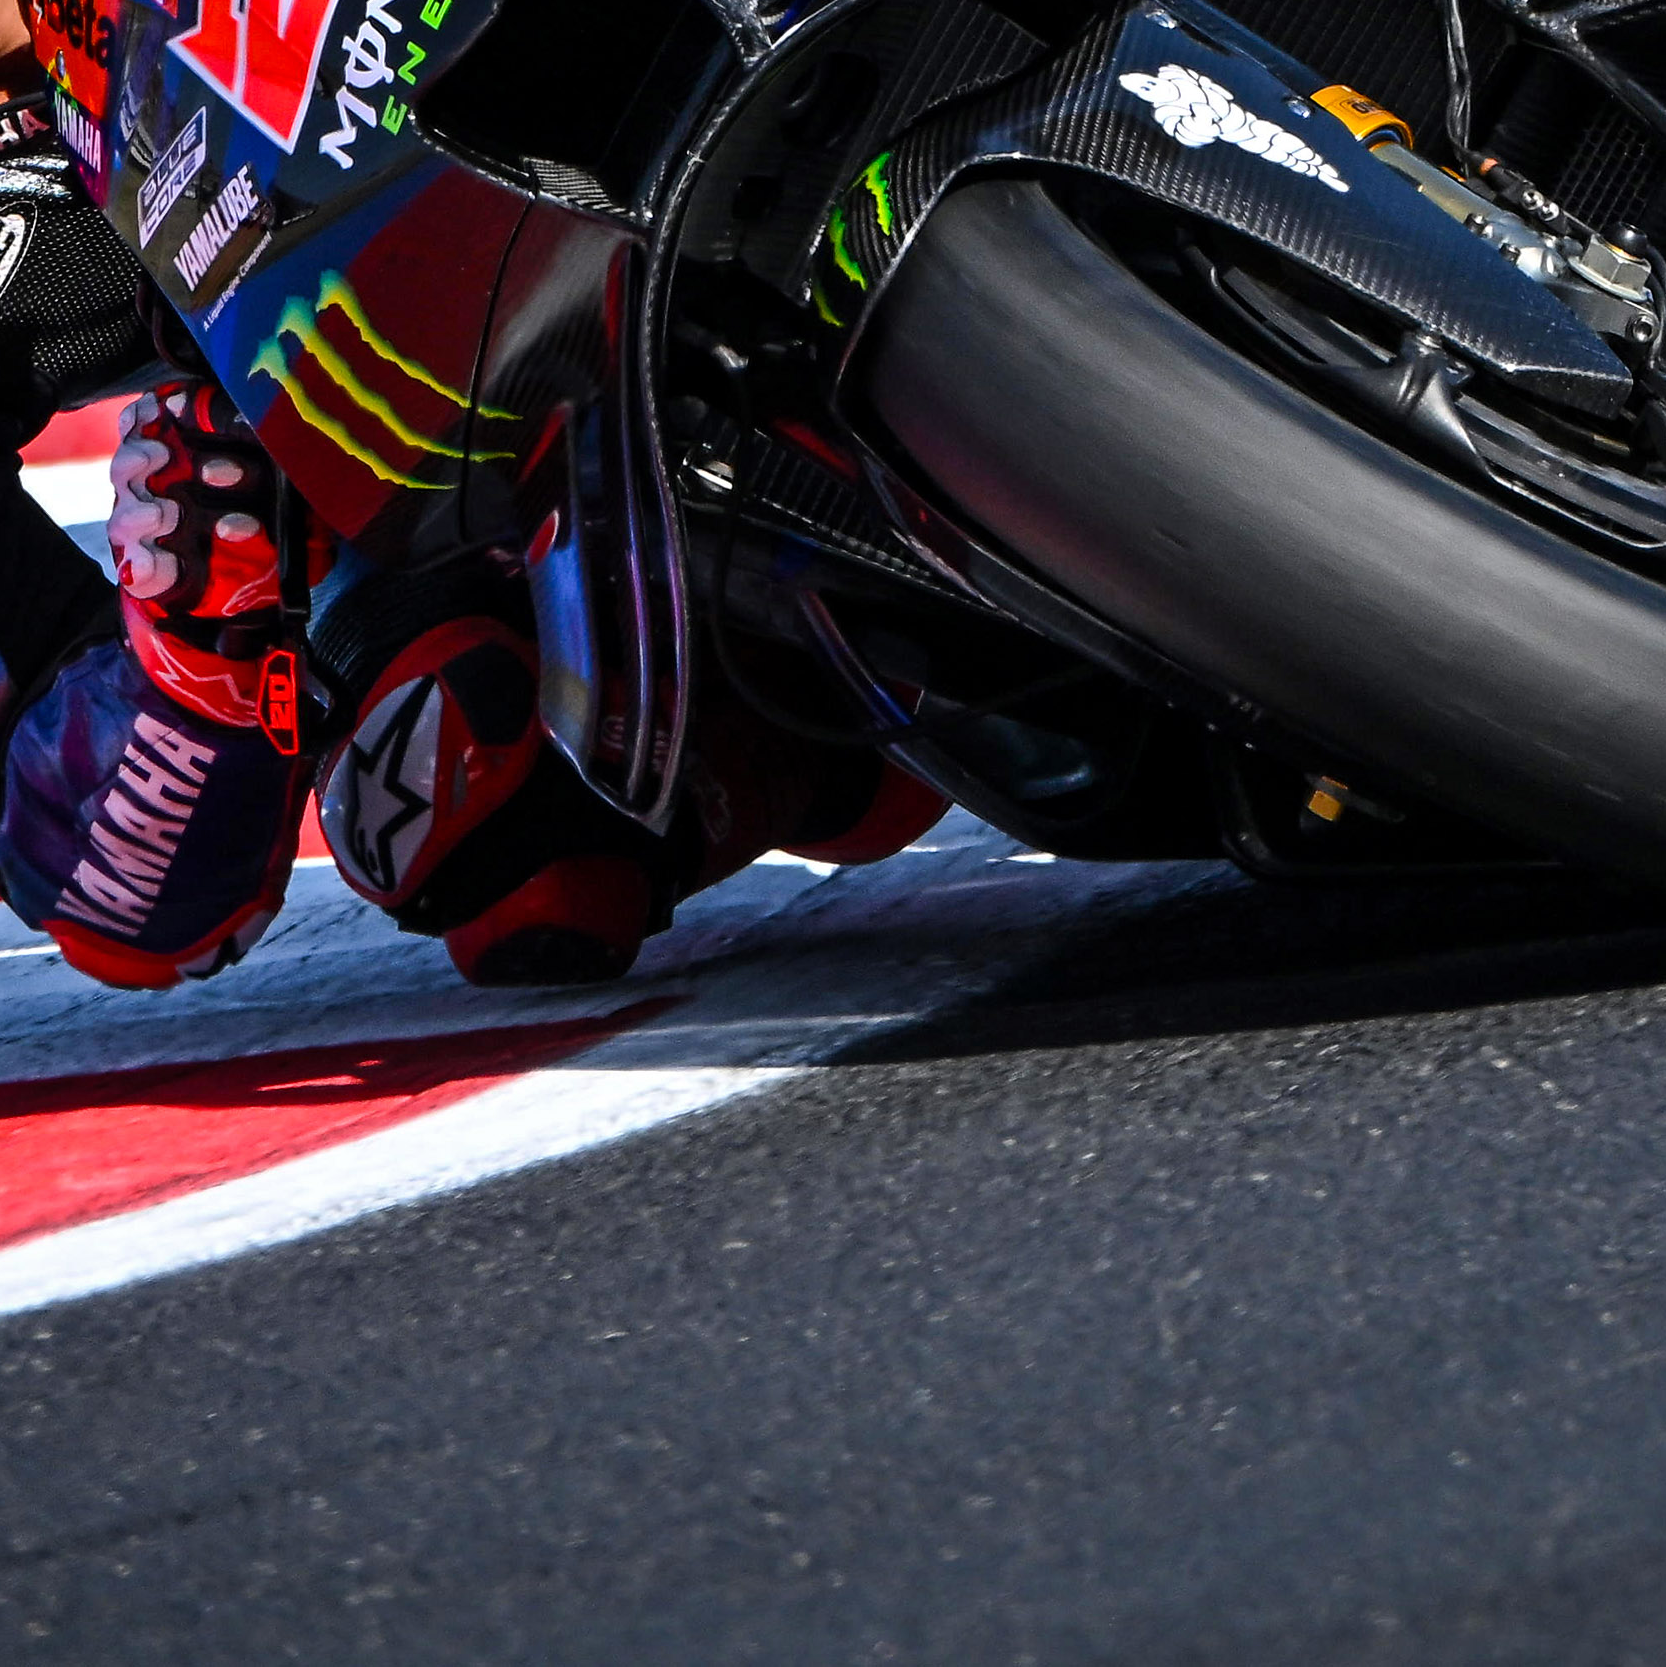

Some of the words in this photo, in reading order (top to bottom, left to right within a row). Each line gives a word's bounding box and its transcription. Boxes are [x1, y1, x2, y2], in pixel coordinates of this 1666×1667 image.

[54, 90, 102, 174] YAMAHA
[142, 122, 197, 206] BLUE
[144, 150, 198, 234] CORE
[173, 163, 260, 292] YAMALUBE
[268, 674, 293, 730] 20
[54, 711, 218, 937] YAMAHA
